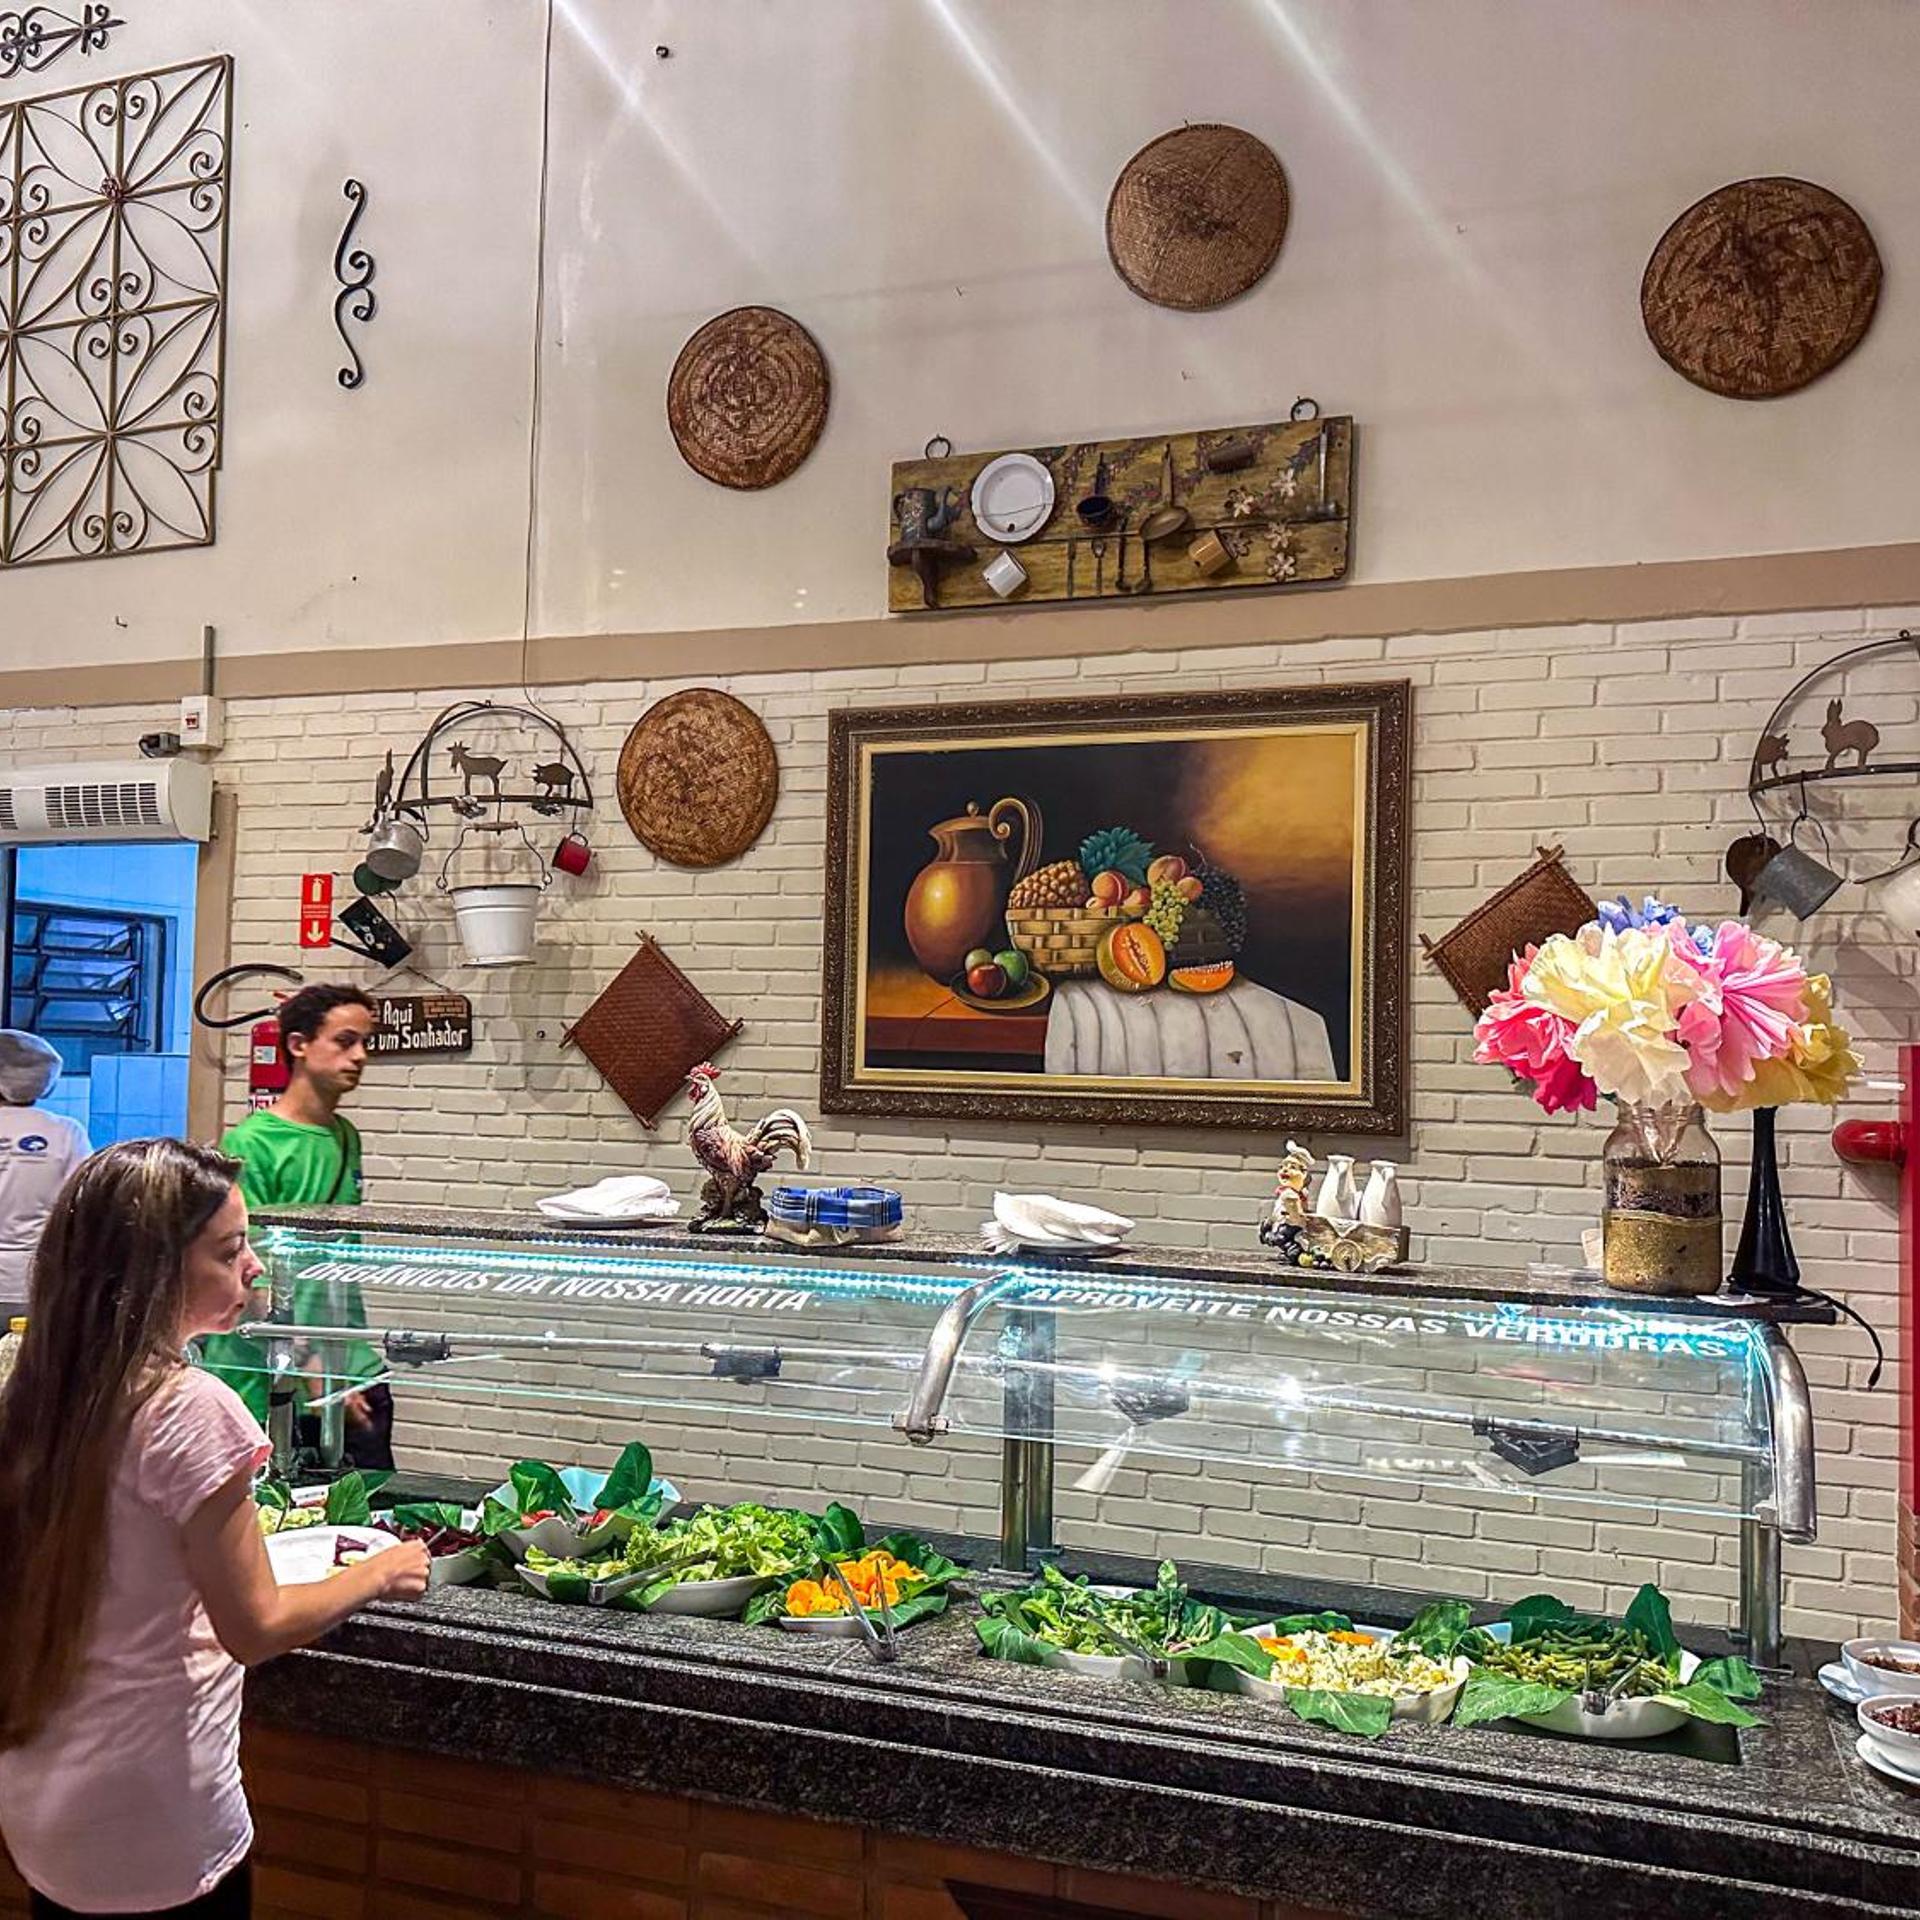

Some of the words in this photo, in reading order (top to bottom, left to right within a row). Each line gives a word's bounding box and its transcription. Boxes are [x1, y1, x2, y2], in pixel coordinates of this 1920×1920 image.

[383, 1000, 413, 1031] Aqui
[378, 1033, 399, 1050] um
[401, 1020, 468, 1049] Sonhador
[494, 1274, 550, 1295] DA
[551, 1276, 682, 1302] NOSSA
[679, 1285, 813, 1311] HORTA
[1022, 1287, 1257, 1318] APROVEITE
[1265, 1306, 1448, 1334] NOSSAS
[1464, 1321, 1728, 1357] VERDURAS
